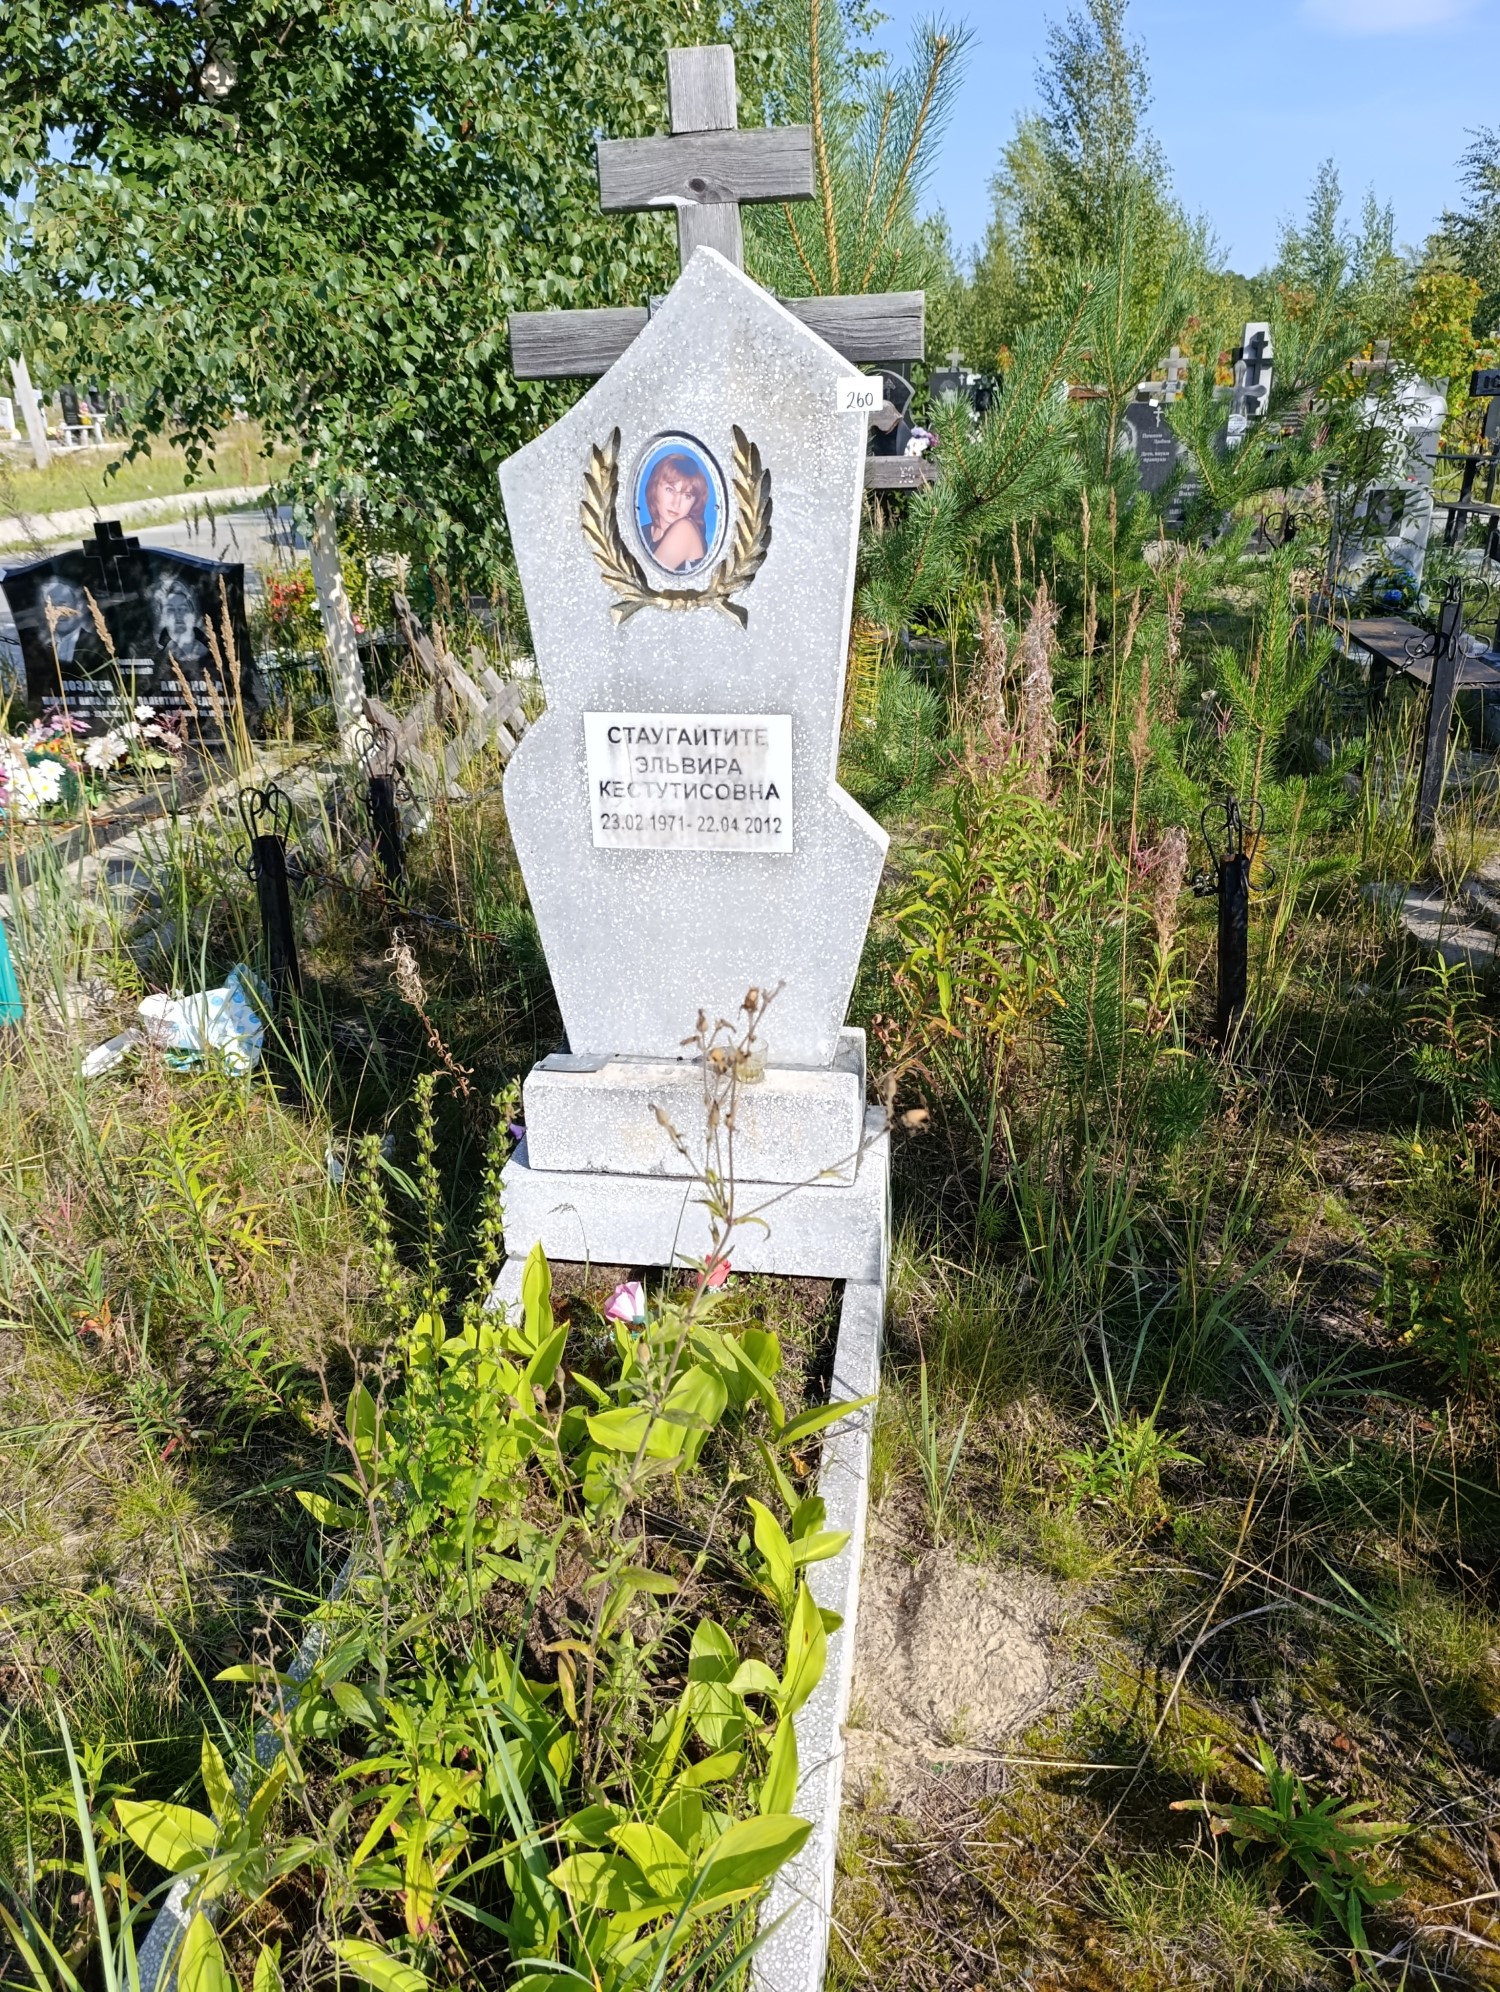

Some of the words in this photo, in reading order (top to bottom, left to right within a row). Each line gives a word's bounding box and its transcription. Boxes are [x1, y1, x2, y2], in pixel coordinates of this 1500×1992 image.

[846, 391, 874, 409] 260
[607, 724, 768, 747] СТАУГАЙТИТЕ
[635, 756, 742, 775] ЭЛЬВИРА
[599, 780, 780, 801] КЕСТУТИСОВНА
